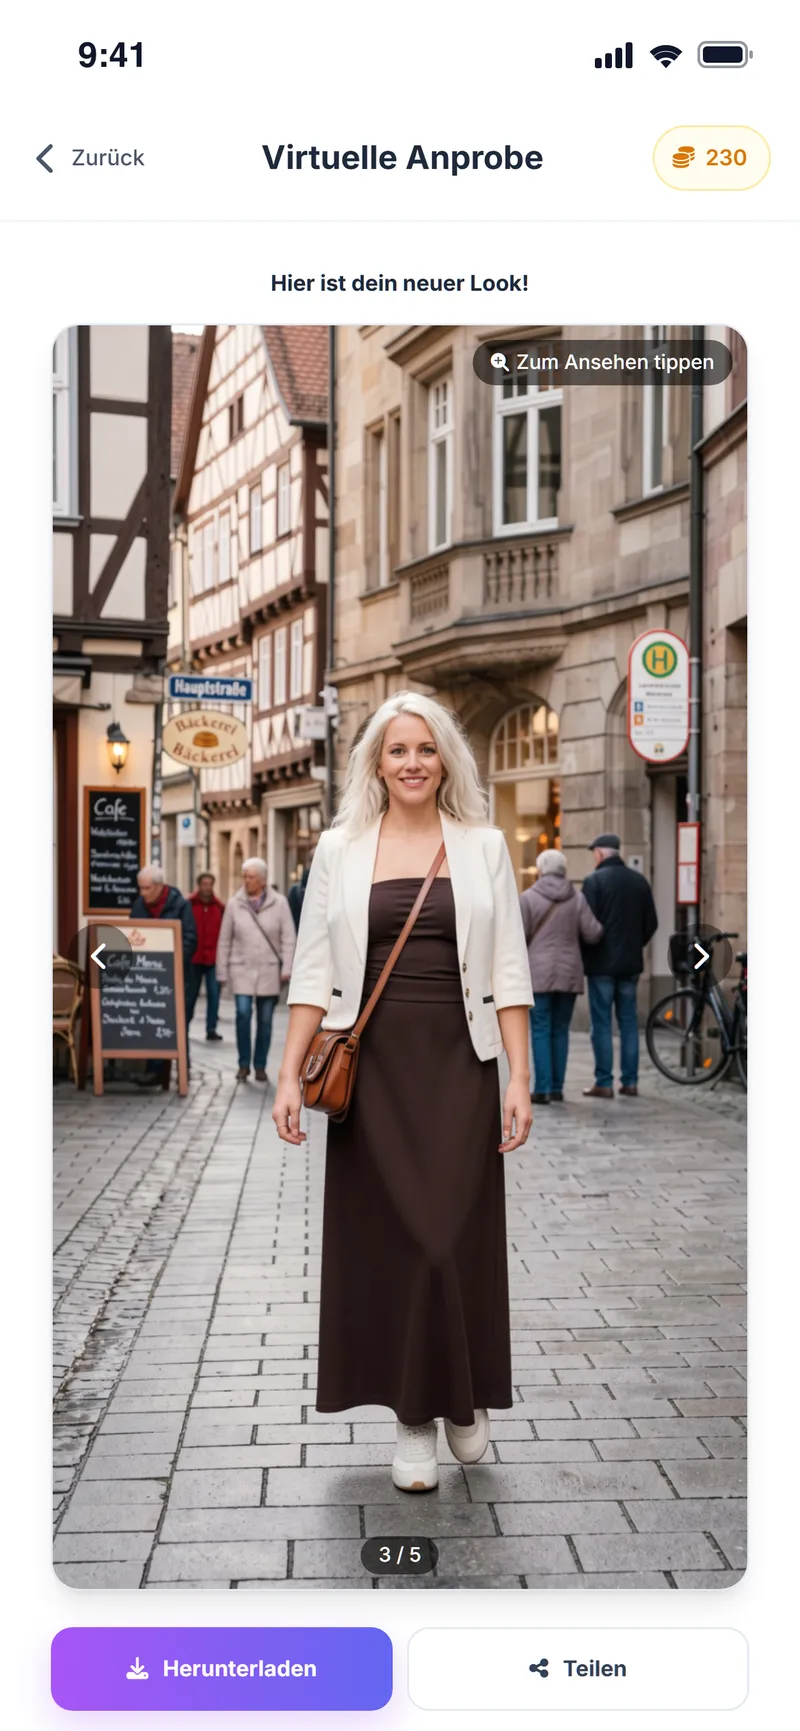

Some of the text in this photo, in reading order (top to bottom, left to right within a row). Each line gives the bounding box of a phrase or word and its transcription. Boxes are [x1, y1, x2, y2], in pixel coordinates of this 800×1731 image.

[78, 41, 143, 69] 9:41
[71, 148, 145, 167] Zurück
[261, 143, 544, 177] Virtuelle Anprobe
[706, 148, 747, 167] 230
[271, 273, 529, 292] Hier ist dein neuer Look!
[652, 648, 668, 670] H
[174, 679, 247, 698] Hauptstraße
[93, 797, 128, 822] Cafe
[163, 1659, 317, 1678] Herunterladen
[562, 1658, 627, 1678] Teilen
